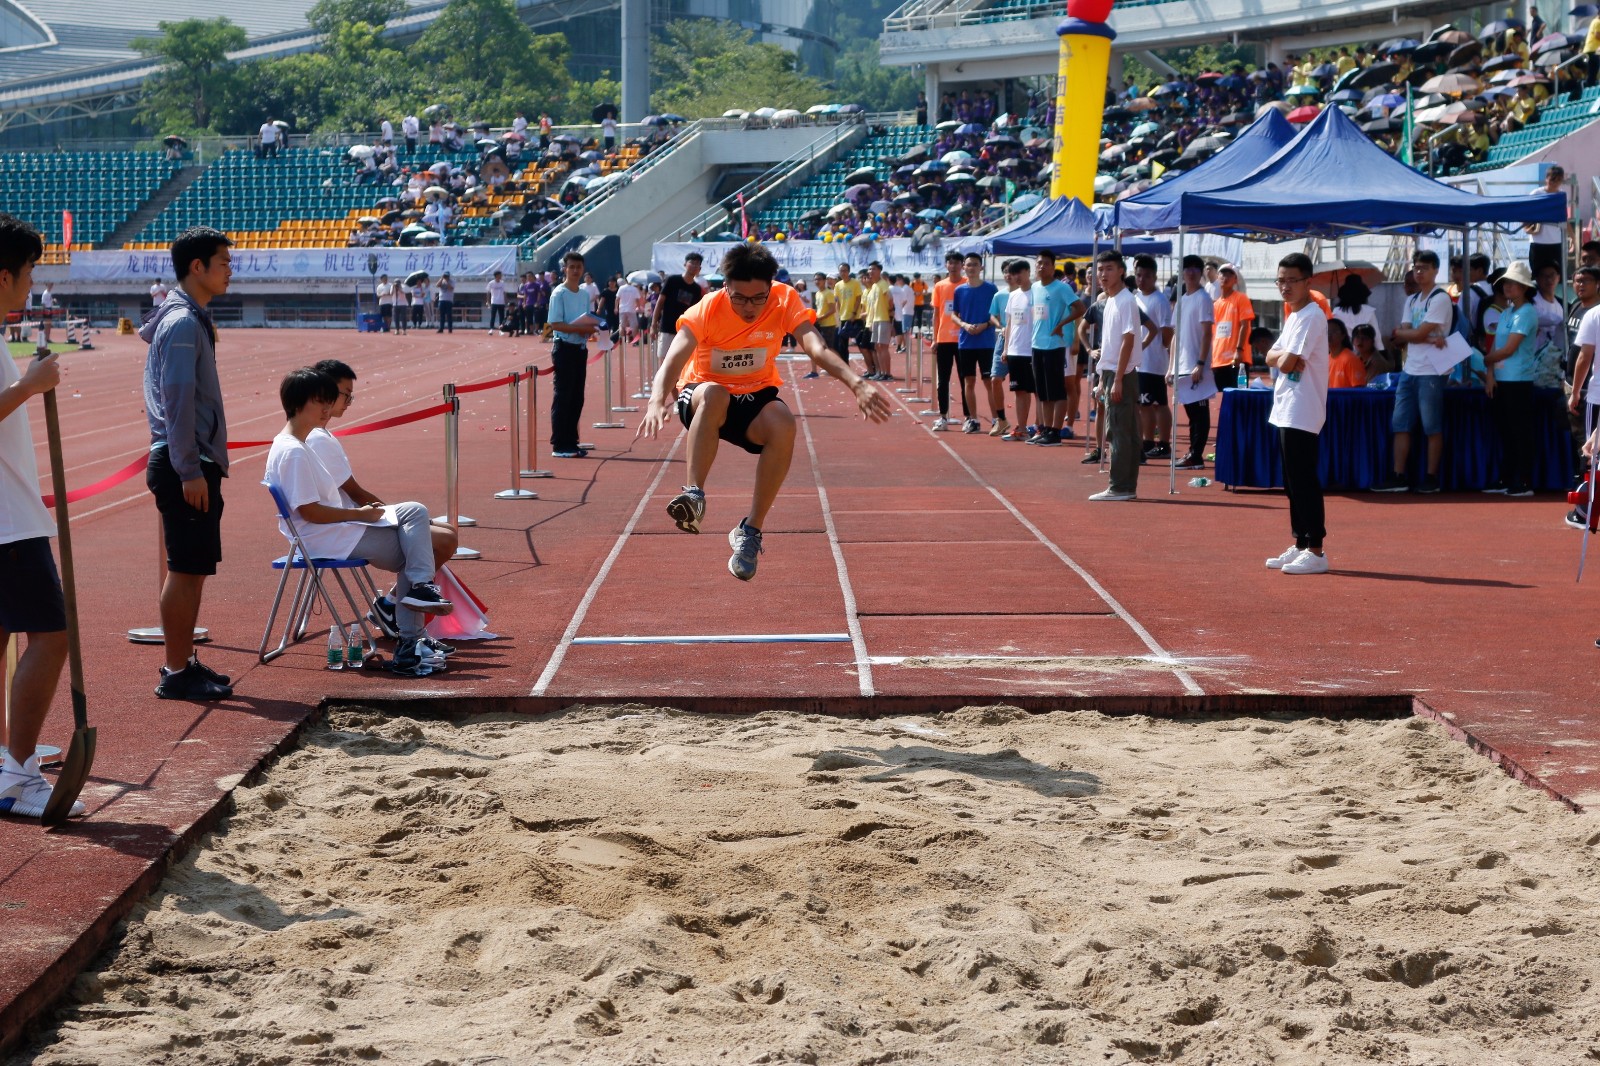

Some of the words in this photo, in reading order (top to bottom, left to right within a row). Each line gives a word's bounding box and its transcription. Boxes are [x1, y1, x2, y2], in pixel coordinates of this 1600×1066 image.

[127, 254, 175, 273] 龙腾四
[230, 253, 279, 273] 舞九天
[324, 252, 390, 272] 机电学院
[404, 251, 469, 272] 奋勇争先
[123, 319, 131, 331] 5
[721, 360, 754, 369] 10403
